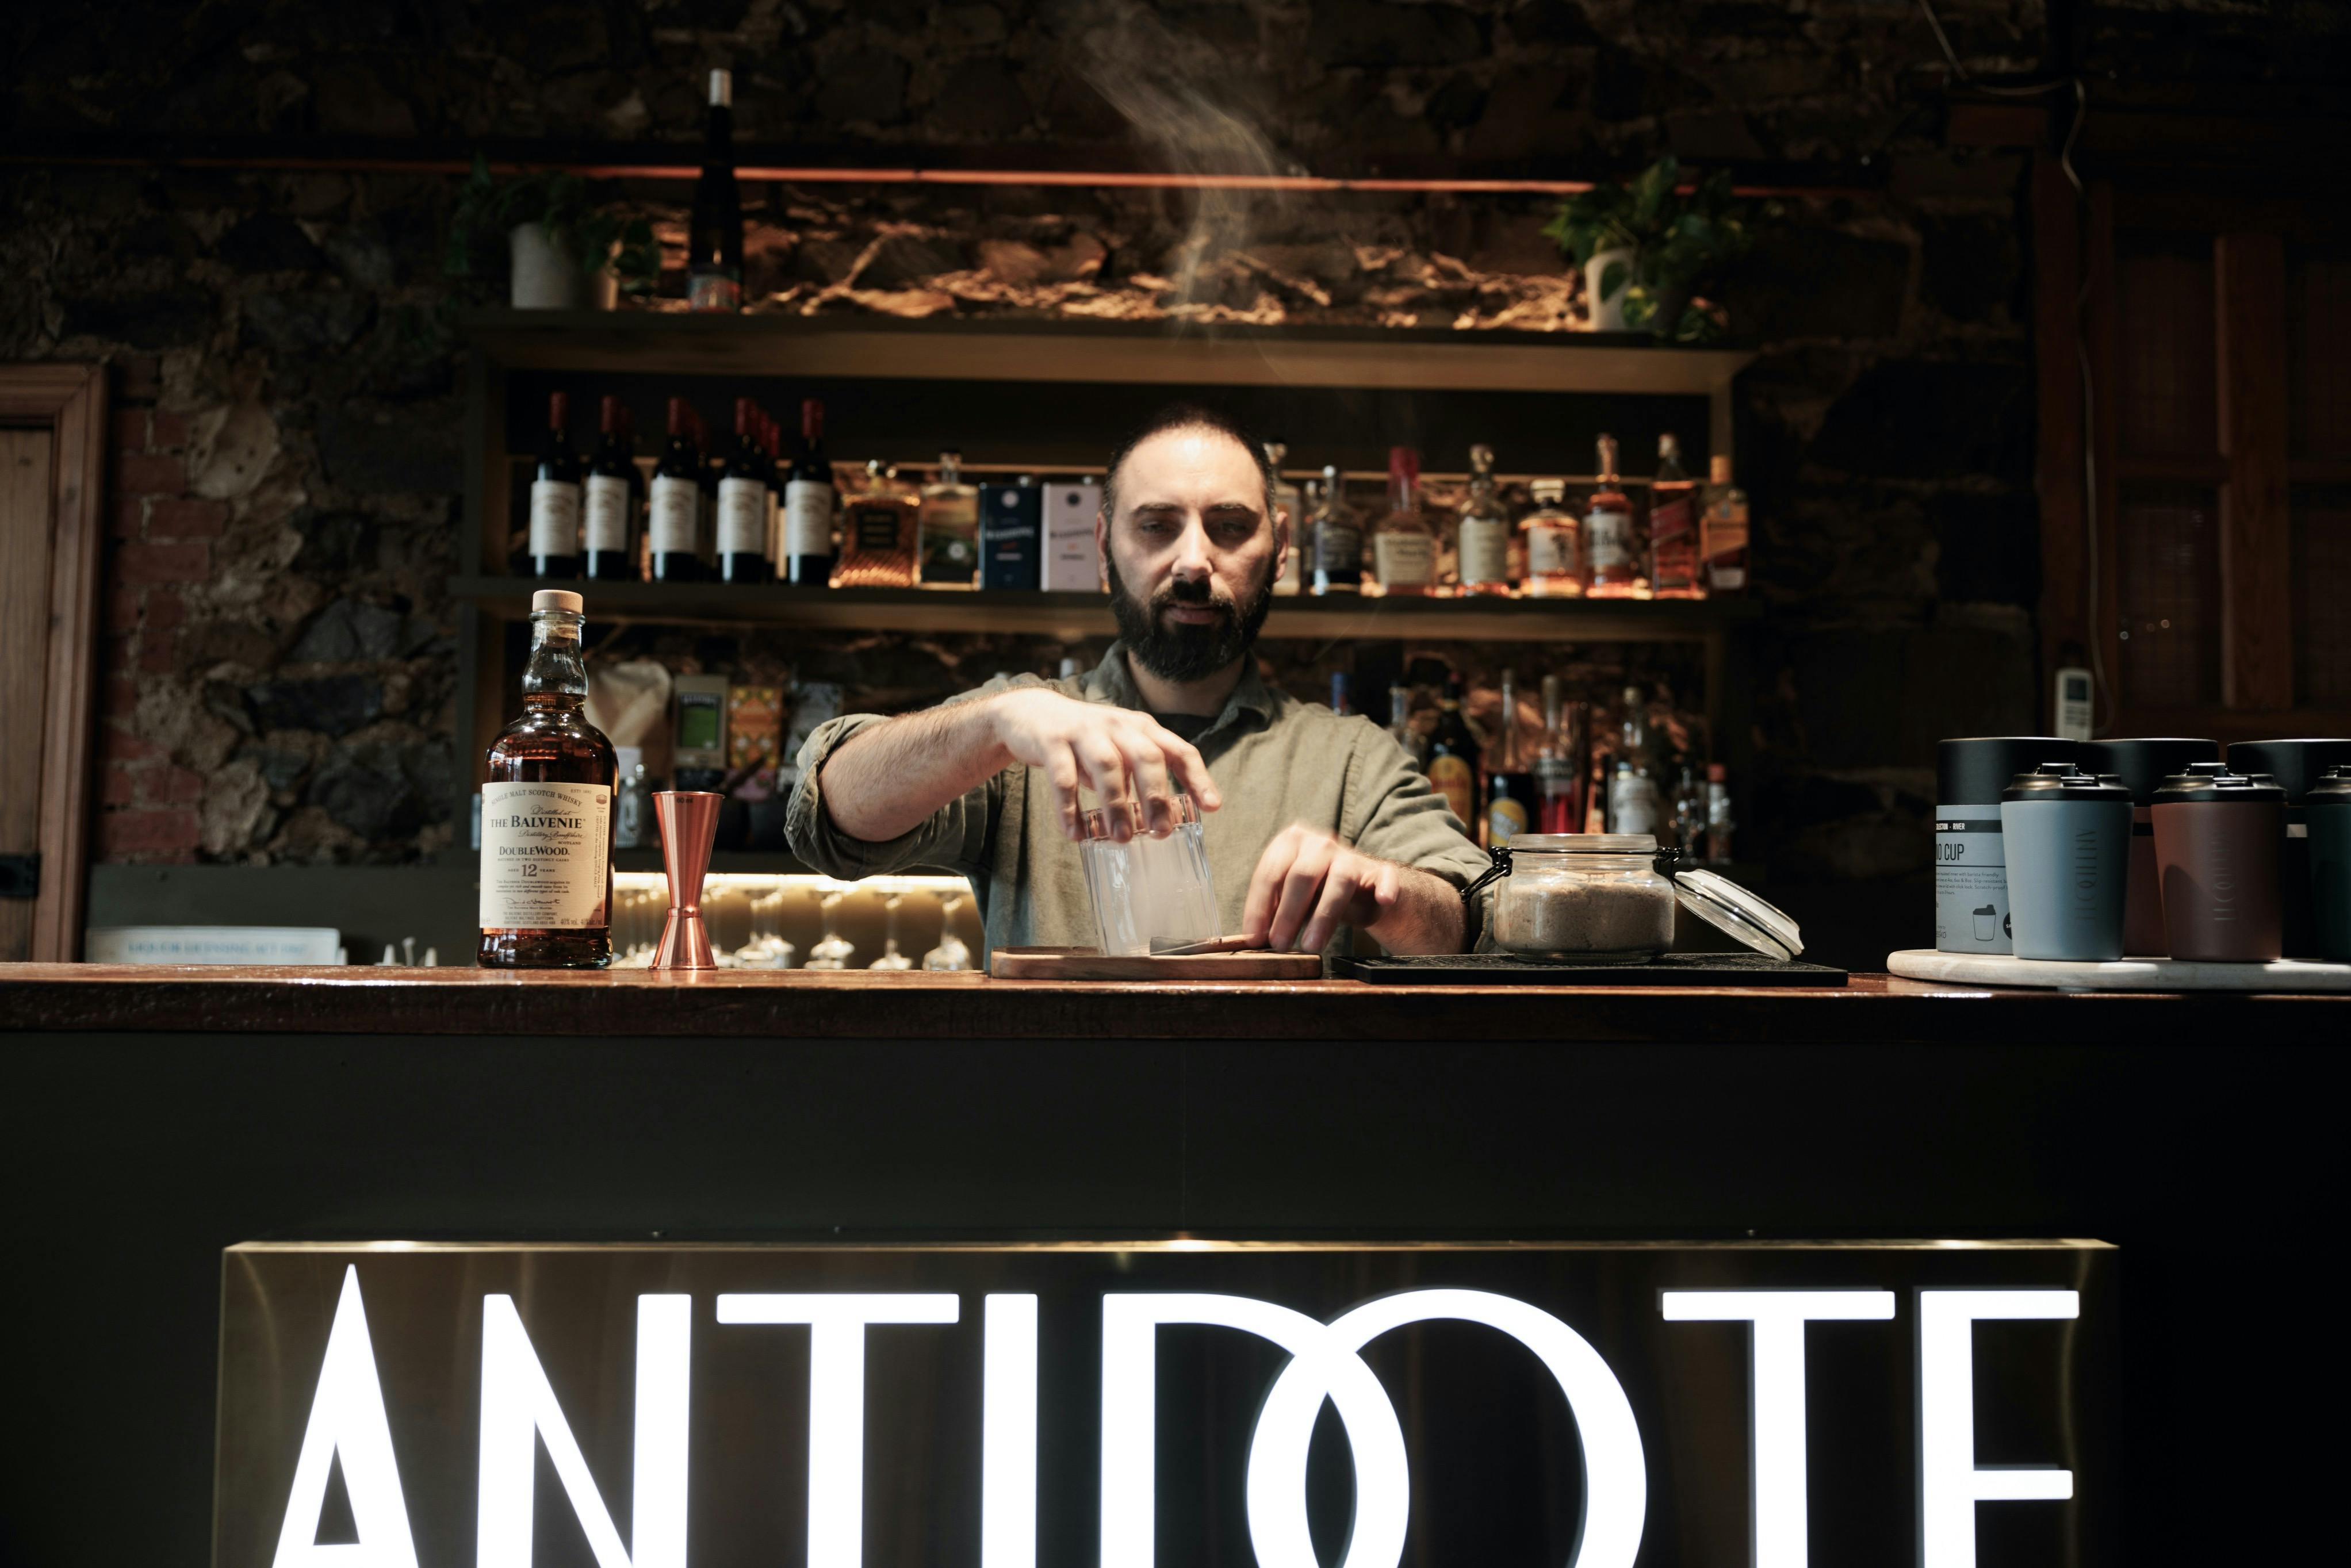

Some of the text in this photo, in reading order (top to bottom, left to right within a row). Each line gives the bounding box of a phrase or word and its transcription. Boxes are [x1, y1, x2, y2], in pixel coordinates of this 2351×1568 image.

[492, 789, 583, 807] SINGLE MALT SCOTCH WHISKY
[530, 804, 563, 815] Distilled
[491, 815, 582, 829] THE BALVENIE
[1944, 843, 1965, 860] CUP
[521, 864, 537, 877] 12
[273, 1270, 2079, 1568] ANTIDOTE
